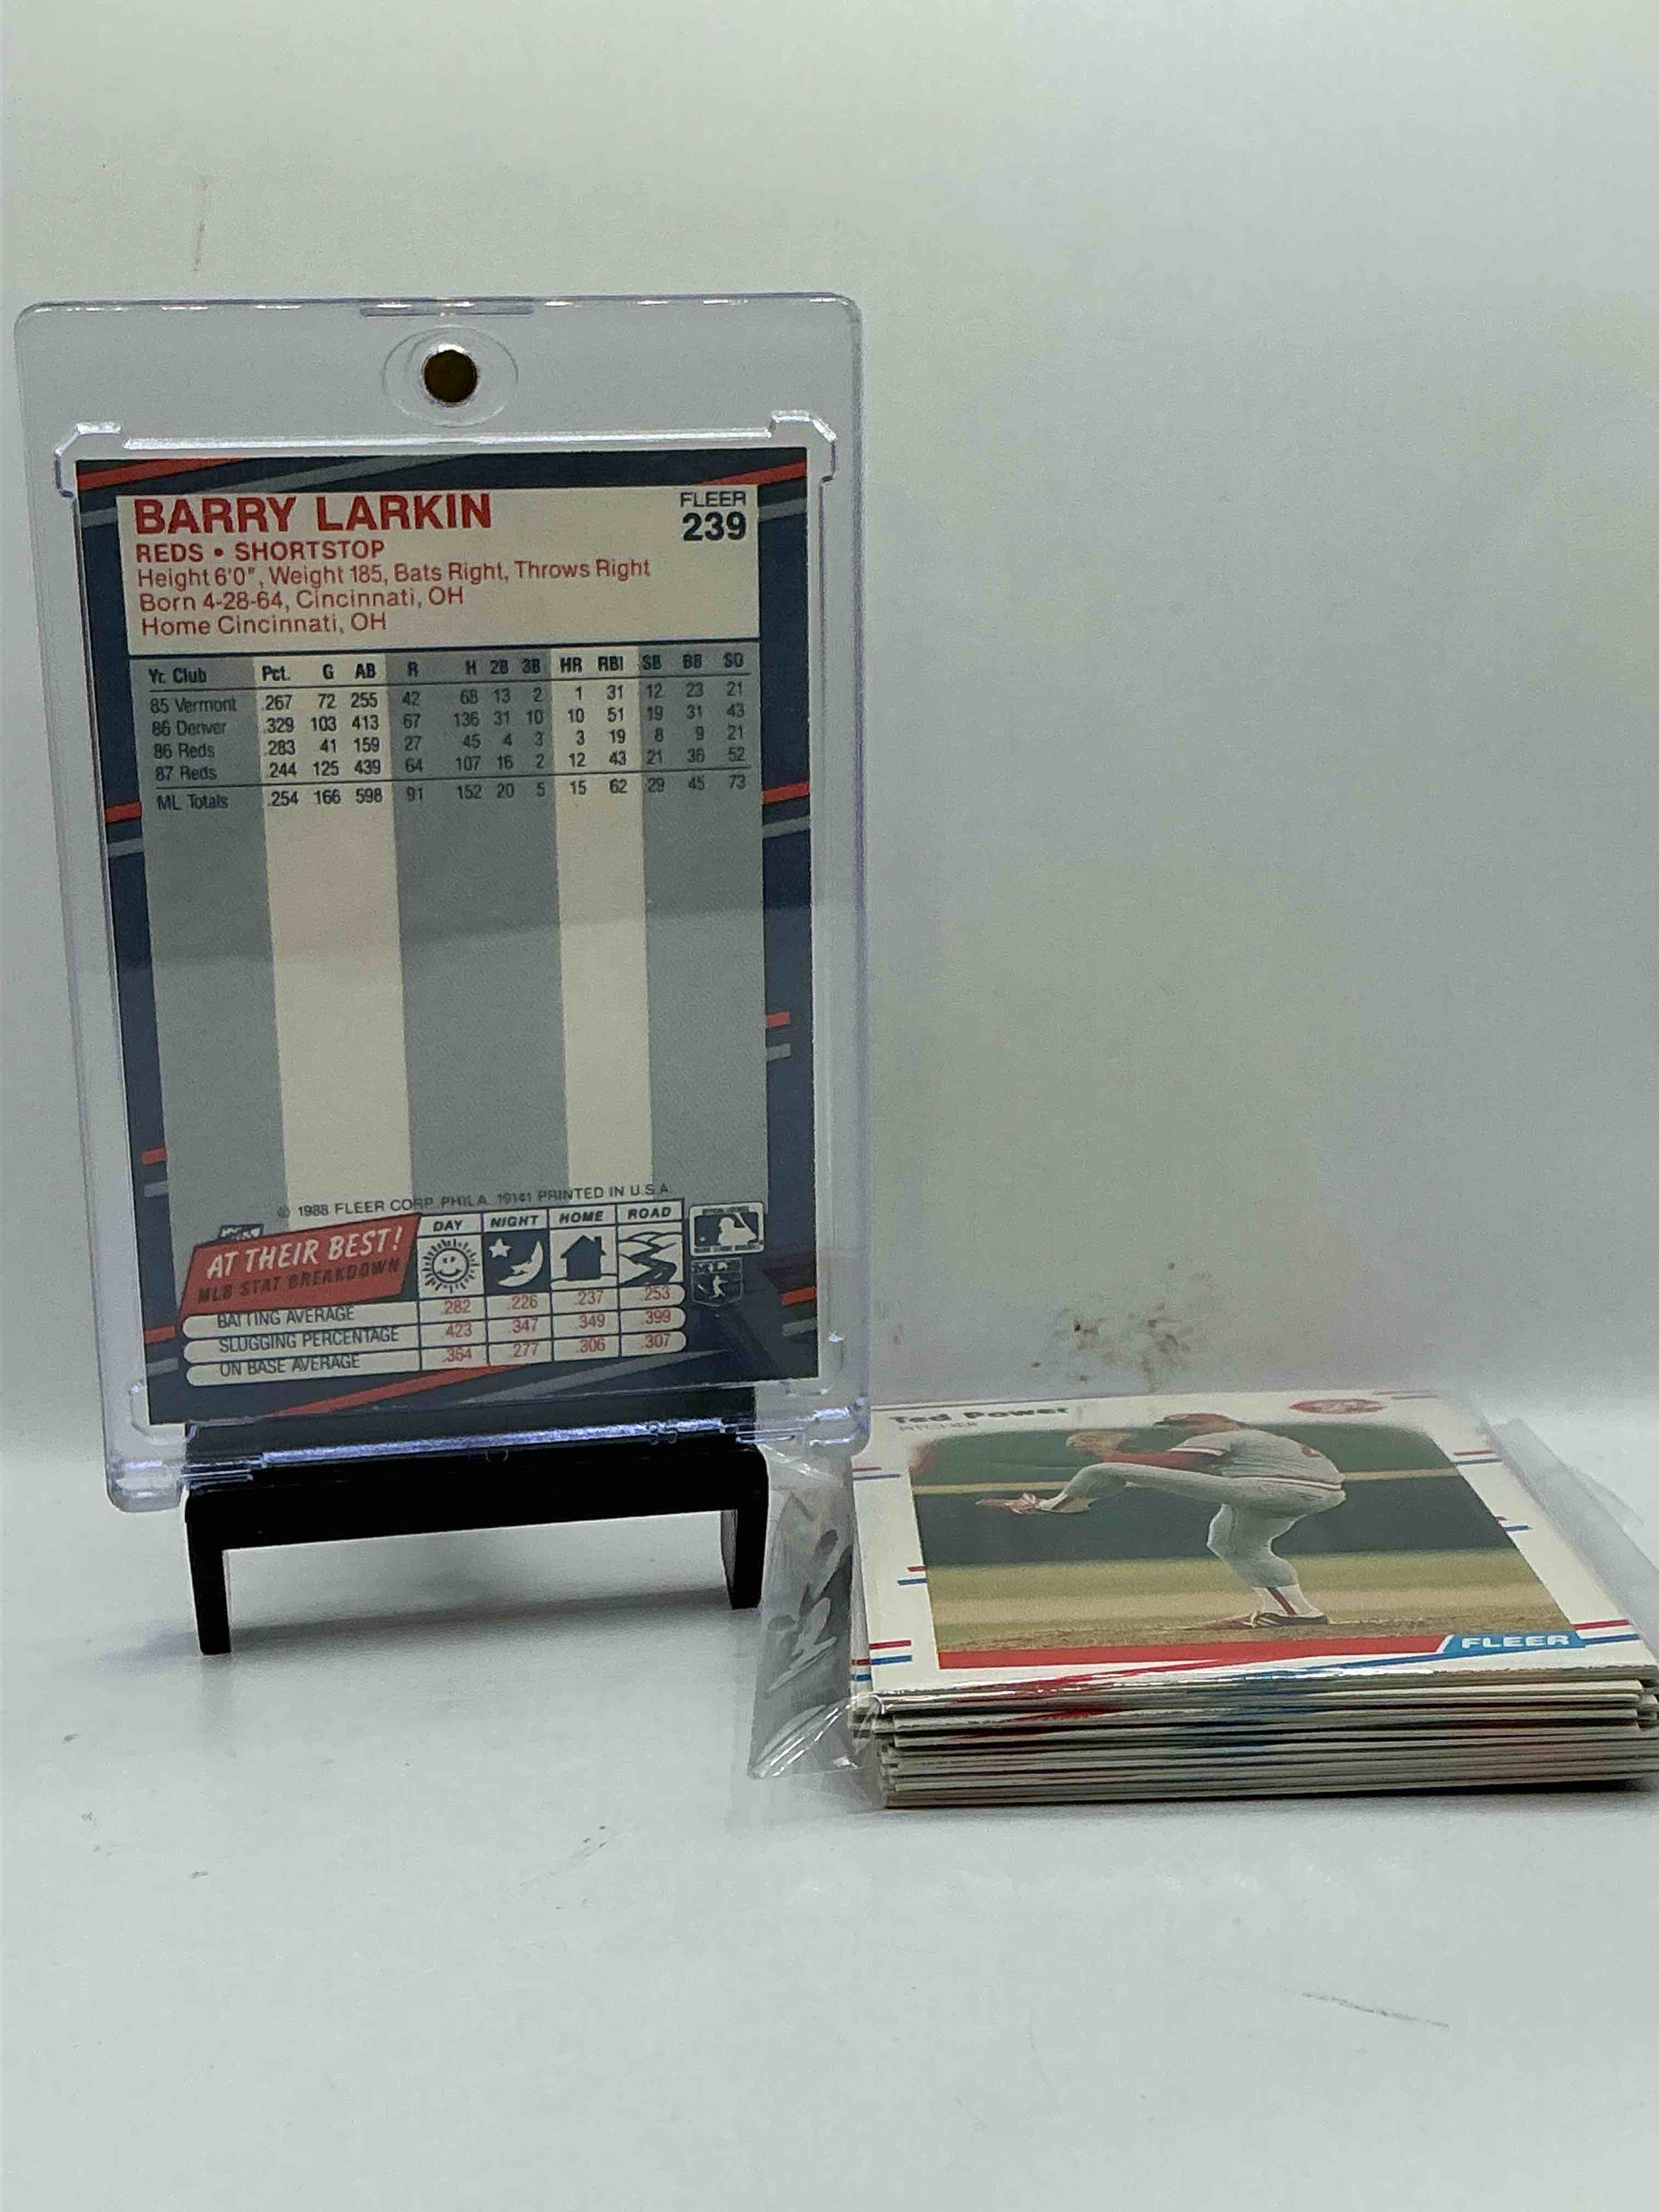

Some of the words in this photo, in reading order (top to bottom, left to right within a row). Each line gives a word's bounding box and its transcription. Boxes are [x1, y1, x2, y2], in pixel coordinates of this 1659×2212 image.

[133, 496, 297, 534] BARRY
[315, 493, 492, 532] LARKIN
[680, 491, 746, 507] FLEER
[682, 511, 746, 541] 239
[136, 542, 204, 563] REDS
[235, 540, 385, 561] SHORTSTOP
[137, 568, 208, 592] Height
[269, 565, 343, 589] Weight
[349, 565, 388, 586] 185,
[394, 563, 442, 583] Bats
[448, 561, 510, 585] Right,
[515, 560, 590, 579] Throws
[595, 558, 650, 582] Right
[140, 592, 195, 612] Born
[203, 590, 290, 613] 4-28-64,
[296, 588, 422, 611] Cincinnati,
[428, 586, 464, 606] OH
[142, 616, 211, 636] Home
[218, 614, 344, 636] Cincinnati,
[351, 612, 385, 631] OH
[173, 667, 207, 684] Club
[323, 664, 334, 680] G
[355, 663, 376, 679] AB
[407, 661, 420, 677] R
[466, 660, 477, 676] H
[490, 659, 509, 675] 2B
[522, 658, 541, 674] 3B
[559, 657, 583, 674] HR
[598, 656, 624, 672] RBI
[641, 654, 662, 670] SB
[682, 653, 702, 669] BB
[724, 653, 744, 668] SO
[150, 697, 169, 714] 85
[174, 696, 236, 713] Vermont
[318, 693, 337, 709] 72
[351, 692, 378, 708] 255
[402, 691, 421, 707] 42
[460, 689, 478, 705] 68
[494, 687, 511, 703] 13
[533, 686, 543, 703] 2
[575, 686, 582, 700] 1
[606, 685, 624, 700] 31
[647, 682, 663, 699] 12
[687, 681, 704, 698] 23
[726, 681, 744, 697] 21
[151, 719, 171, 736] 86
[177, 719, 226, 736] Denver
[311, 715, 337, 732] 103
[352, 714, 379, 730] 413
[403, 713, 421, 729] 67
[454, 712, 480, 727] 136
[493, 710, 510, 726] 31
[526, 709, 544, 725] 10
[568, 708, 584, 724] 10
[607, 707, 624, 722] 51
[647, 706, 663, 721] 19
[686, 704, 703, 720] 31
[726, 703, 744, 718] 43
[154, 743, 172, 760] 86
[178, 742, 215, 759] Reds
[320, 738, 337, 754] 41
[353, 737, 380, 753] 159
[404, 736, 421, 752] 27
[461, 734, 481, 749] 45
[502, 732, 512, 747] 4
[534, 731, 543, 747] 3
[577, 730, 585, 746] 3
[609, 729, 626, 744] 19
[654, 728, 663, 743] 8
[696, 726, 704, 741] 9
[727, 725, 743, 741] 21
[155, 765, 173, 782] 87
[180, 765, 218, 781] Reds
[312, 760, 339, 776] 125
[354, 759, 381, 775] 439
[405, 757, 423, 773] 64
[456, 755, 481, 771] 107
[496, 754, 514, 769] 16
[535, 753, 545, 769] 2
[568, 752, 586, 768] 12
[609, 751, 627, 766] 43
[647, 749, 663, 765] 21
[687, 748, 705, 763] 36
[727, 746, 745, 762] 52
[156, 794, 181, 811] ML
[187, 793, 229, 809] Totals
[314, 788, 341, 805] 166
[356, 787, 382, 804] 598
[407, 786, 423, 802] 91
[457, 785, 482, 800] 152
[496, 783, 515, 799] 20
[537, 781, 545, 797] 5
[571, 780, 586, 795] 15
[610, 778, 628, 794] 62
[647, 777, 665, 793] 29
[688, 775, 705, 791] 45
[730, 774, 746, 789] 73
[298, 1204, 329, 1217] 1988
[334, 1200, 385, 1215] FLEER
[538, 1186, 603, 1203] PRINTED
[610, 1185, 624, 1198] IN
[433, 1220, 463, 1232] DAY
[490, 1215, 539, 1228] NIGHT
[559, 1210, 603, 1224] HOME
[628, 1206, 672, 1220] ROAD
[206, 1251, 238, 1279] AT
[245, 1239, 319, 1273] THEIR
[329, 1226, 402, 1262] BEST!
[198, 1284, 232, 1304] MLB
[240, 1276, 281, 1296] STAT
[289, 1258, 400, 1289] BREAKDOWN
[217, 1310, 281, 1329] BATTING
[286, 1305, 355, 1324] AVERAGE
[220, 1333, 296, 1353] SLUGGING
[303, 1326, 399, 1347] PERCENTAGE
[220, 1361, 241, 1378] ON
[247, 1358, 285, 1375] BASE
[292, 1353, 360, 1372] AVERAGE
[889, 1413, 952, 1423] Ted
[963, 1407, 1068, 1419] Power
[1460, 1634, 1570, 1649] FLEER
